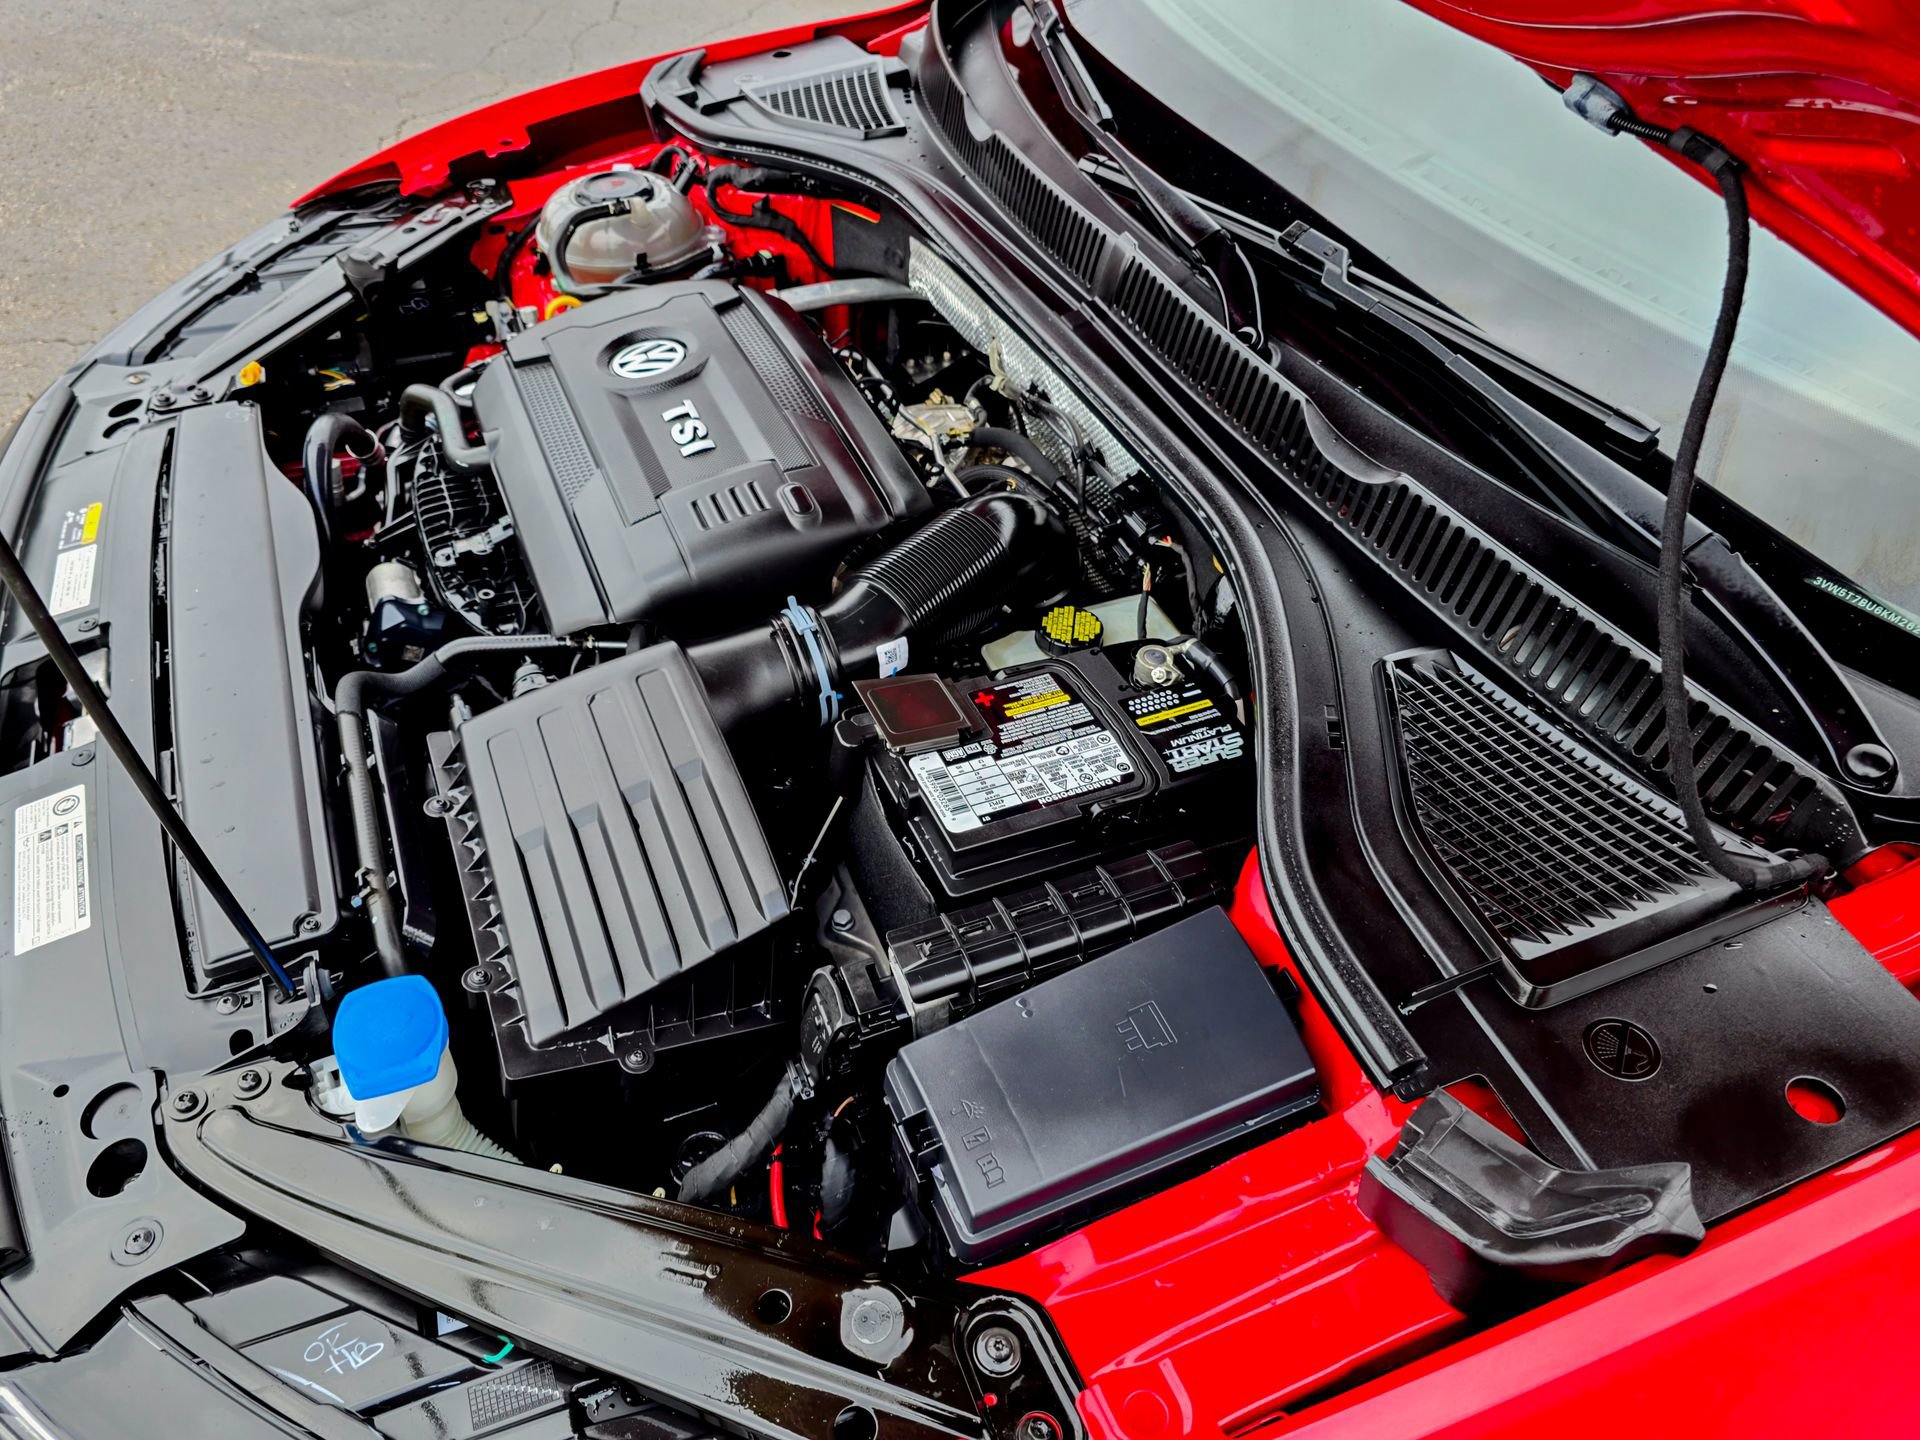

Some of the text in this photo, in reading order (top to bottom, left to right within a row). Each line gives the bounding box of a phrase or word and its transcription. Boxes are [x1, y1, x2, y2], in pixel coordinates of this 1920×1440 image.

[661, 400, 716, 458] TSI
[1169, 723, 1232, 747] PLATINUM
[1170, 731, 1244, 763] START
[1171, 744, 1243, 772] SUPER
[987, 798, 1005, 807] 47PLT
[1038, 779, 1111, 804] DANGER/POISON
